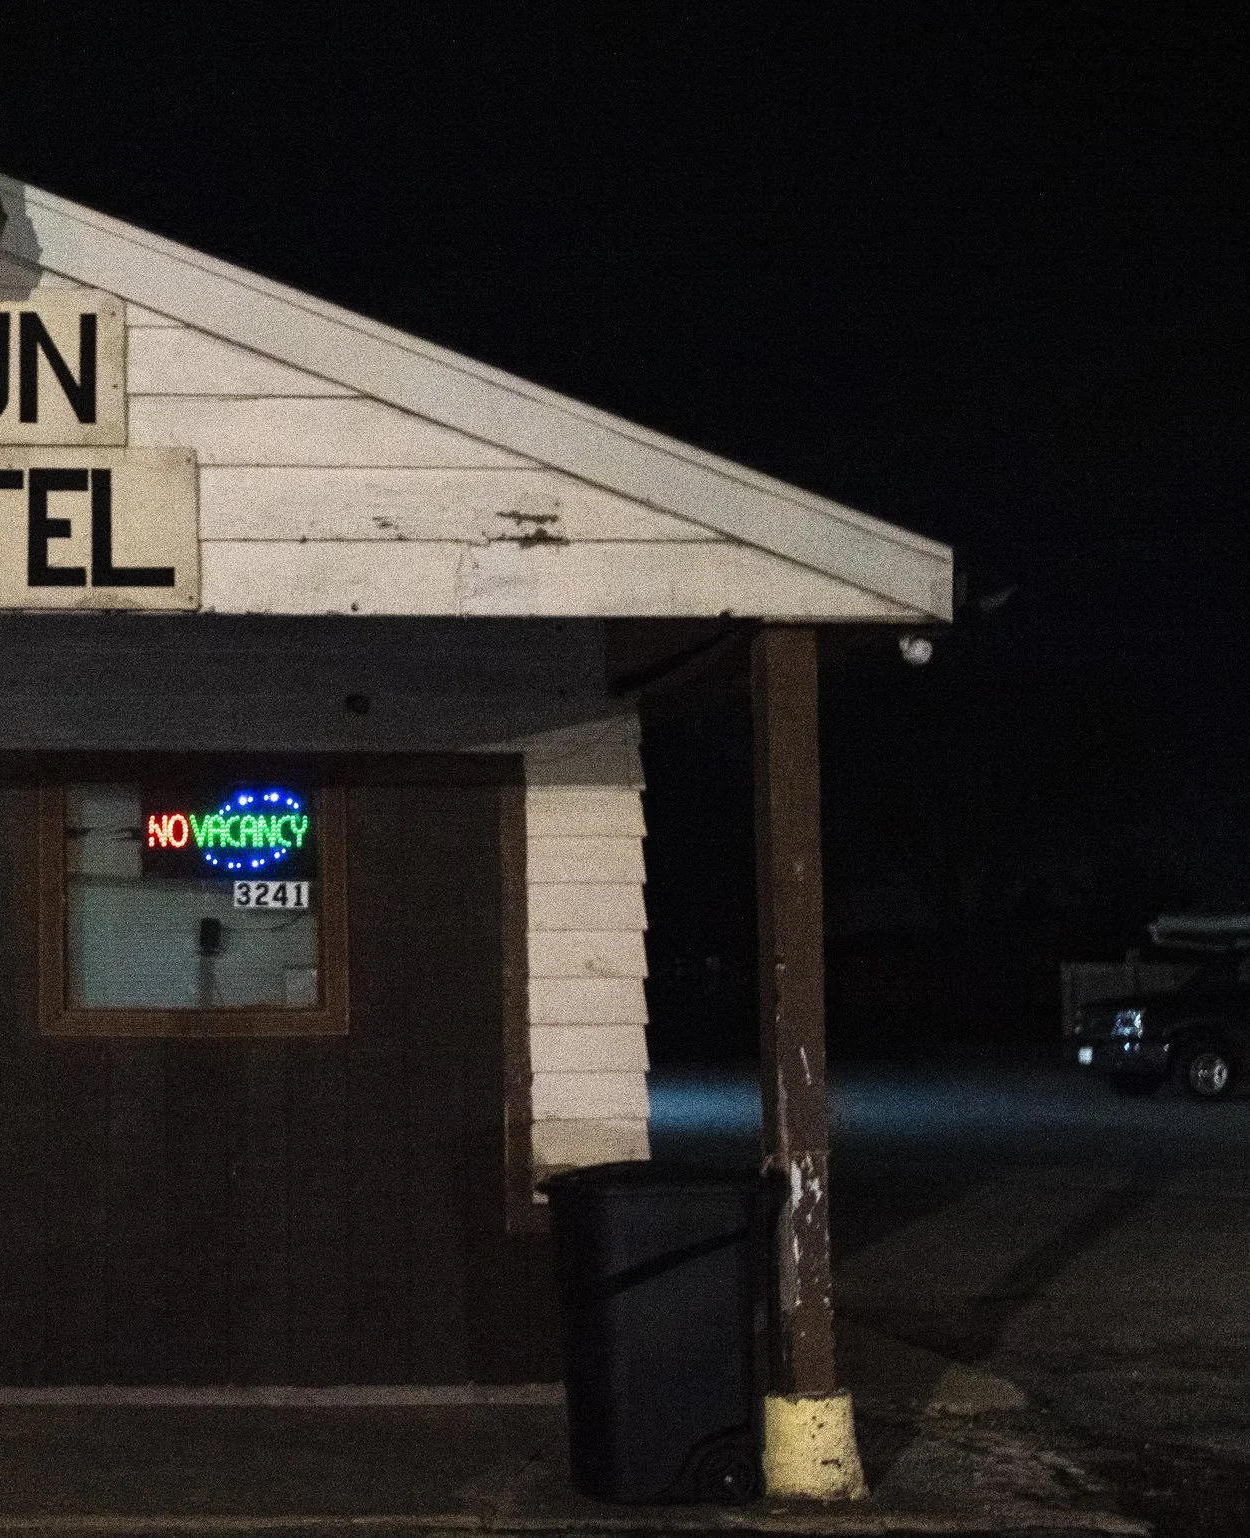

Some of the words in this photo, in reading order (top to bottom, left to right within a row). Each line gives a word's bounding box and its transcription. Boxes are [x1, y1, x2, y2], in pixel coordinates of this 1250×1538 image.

[148, 814, 189, 848] NO
[189, 814, 309, 848] VACANCY
[236, 882, 304, 906] 3241
